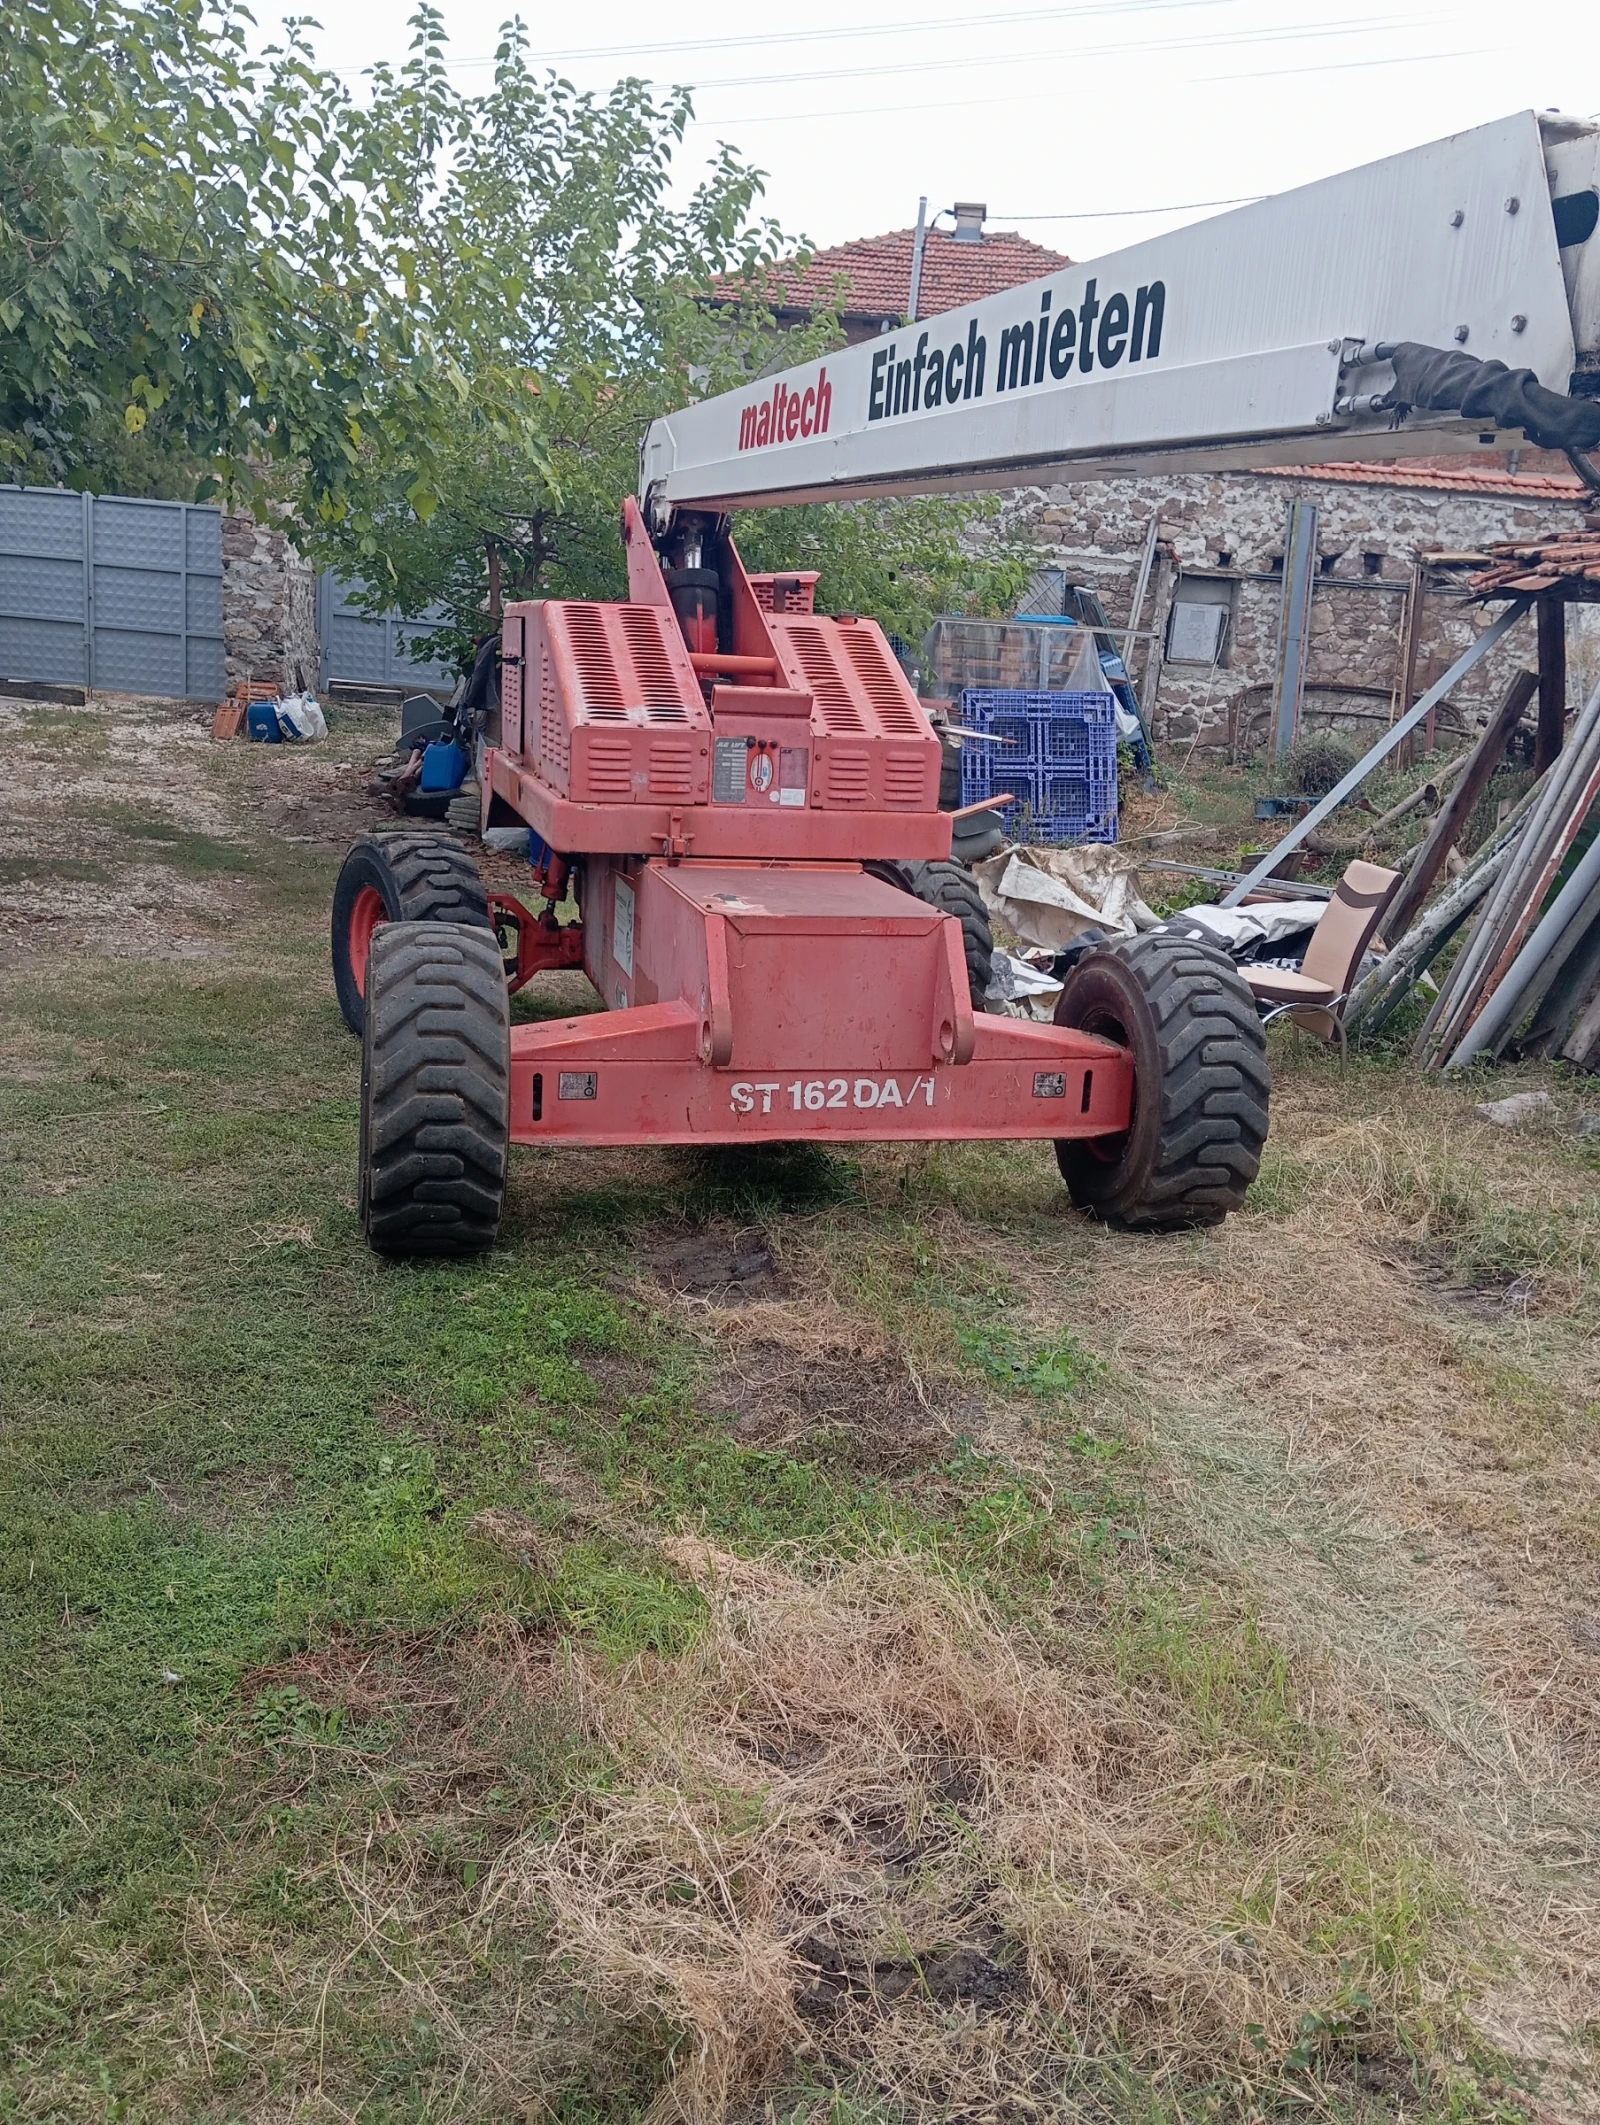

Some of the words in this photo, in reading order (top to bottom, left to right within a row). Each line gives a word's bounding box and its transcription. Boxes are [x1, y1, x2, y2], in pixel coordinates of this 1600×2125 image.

[868, 318, 987, 421] Einfach
[996, 277, 1166, 392] mieten
[738, 366, 833, 451] maltech
[729, 1082, 780, 1113] ST
